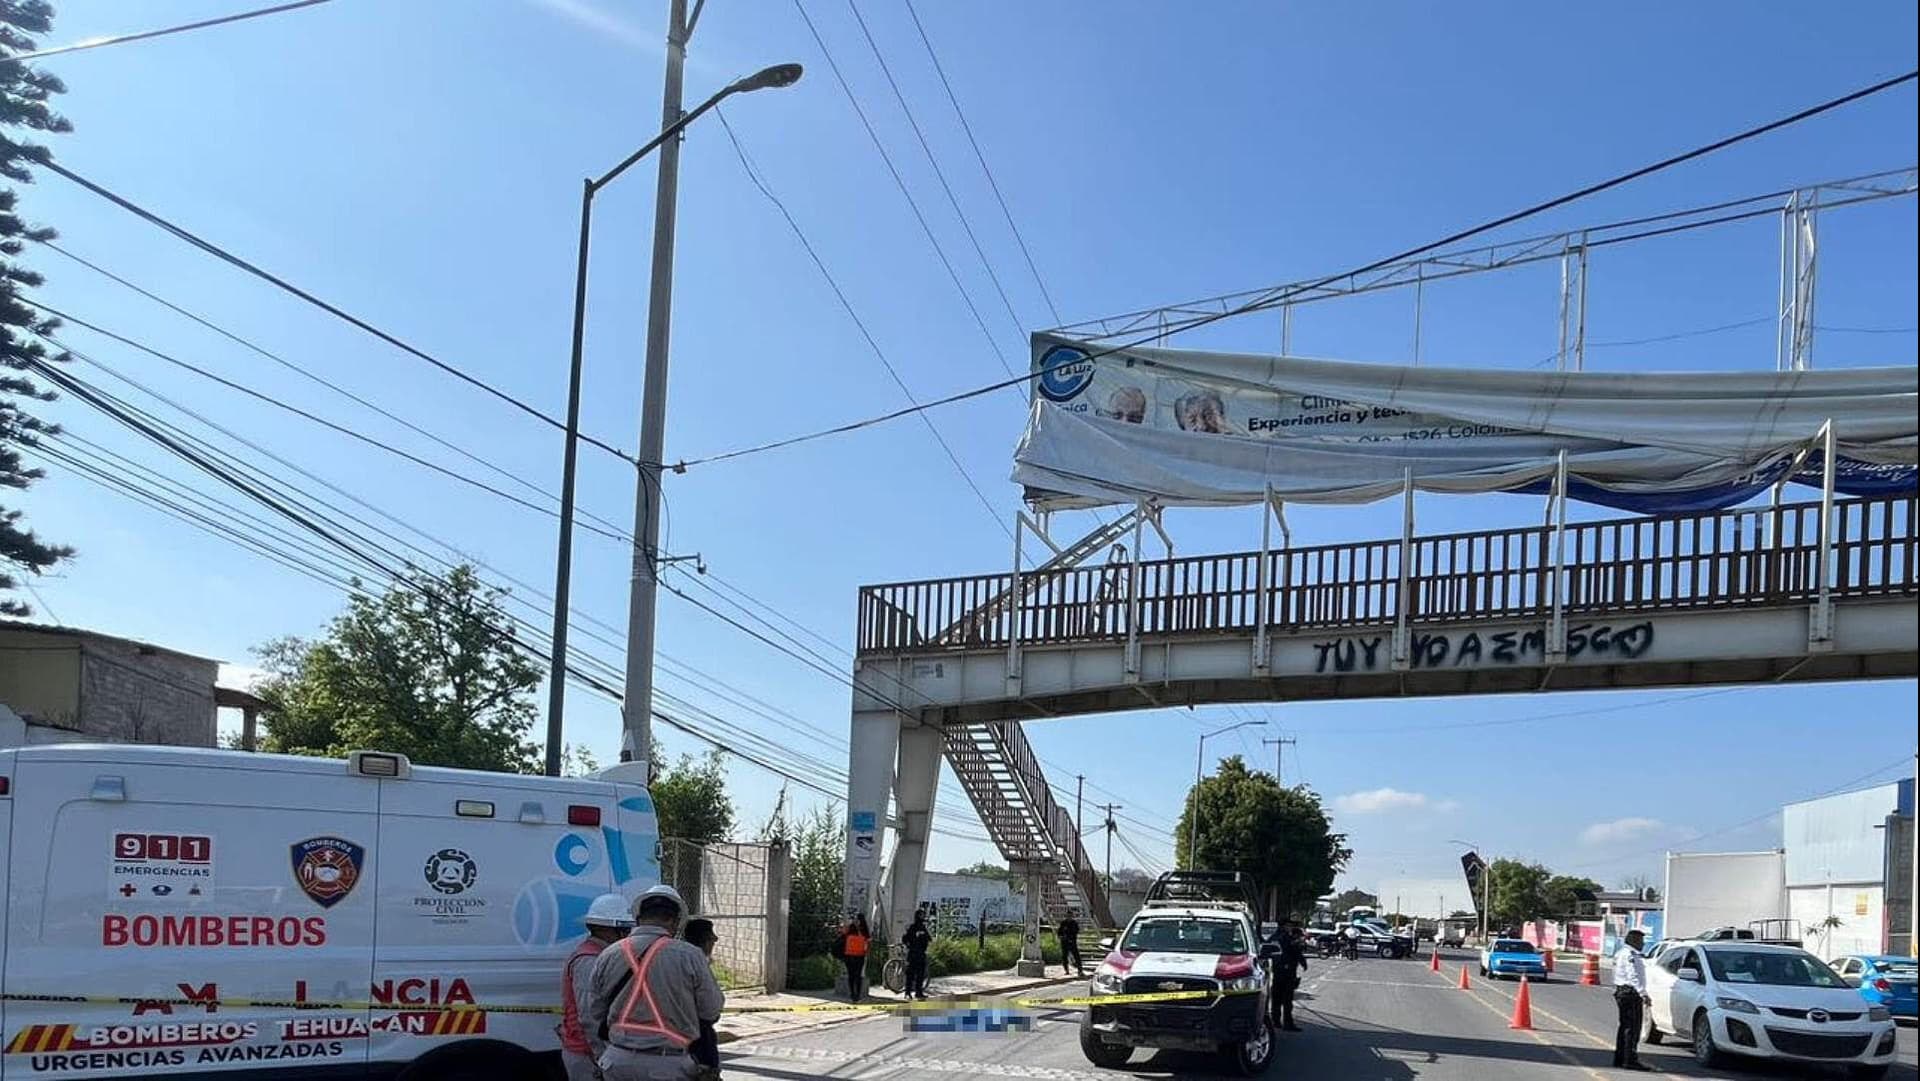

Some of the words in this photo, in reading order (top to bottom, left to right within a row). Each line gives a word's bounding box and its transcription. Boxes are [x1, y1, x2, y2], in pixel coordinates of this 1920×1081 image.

[1248, 410, 1351, 432] Experiencia
[1356, 410, 1368, 424] y
[121, 836, 202, 859] 911
[114, 865, 211, 877] EMERGENCIAS
[102, 914, 327, 947] BOMBEROS
[89, 1021, 258, 1046] BOMBEROS
[32, 1050, 185, 1072] URGENCIAS
[197, 1041, 344, 1064] AVANZADAS
